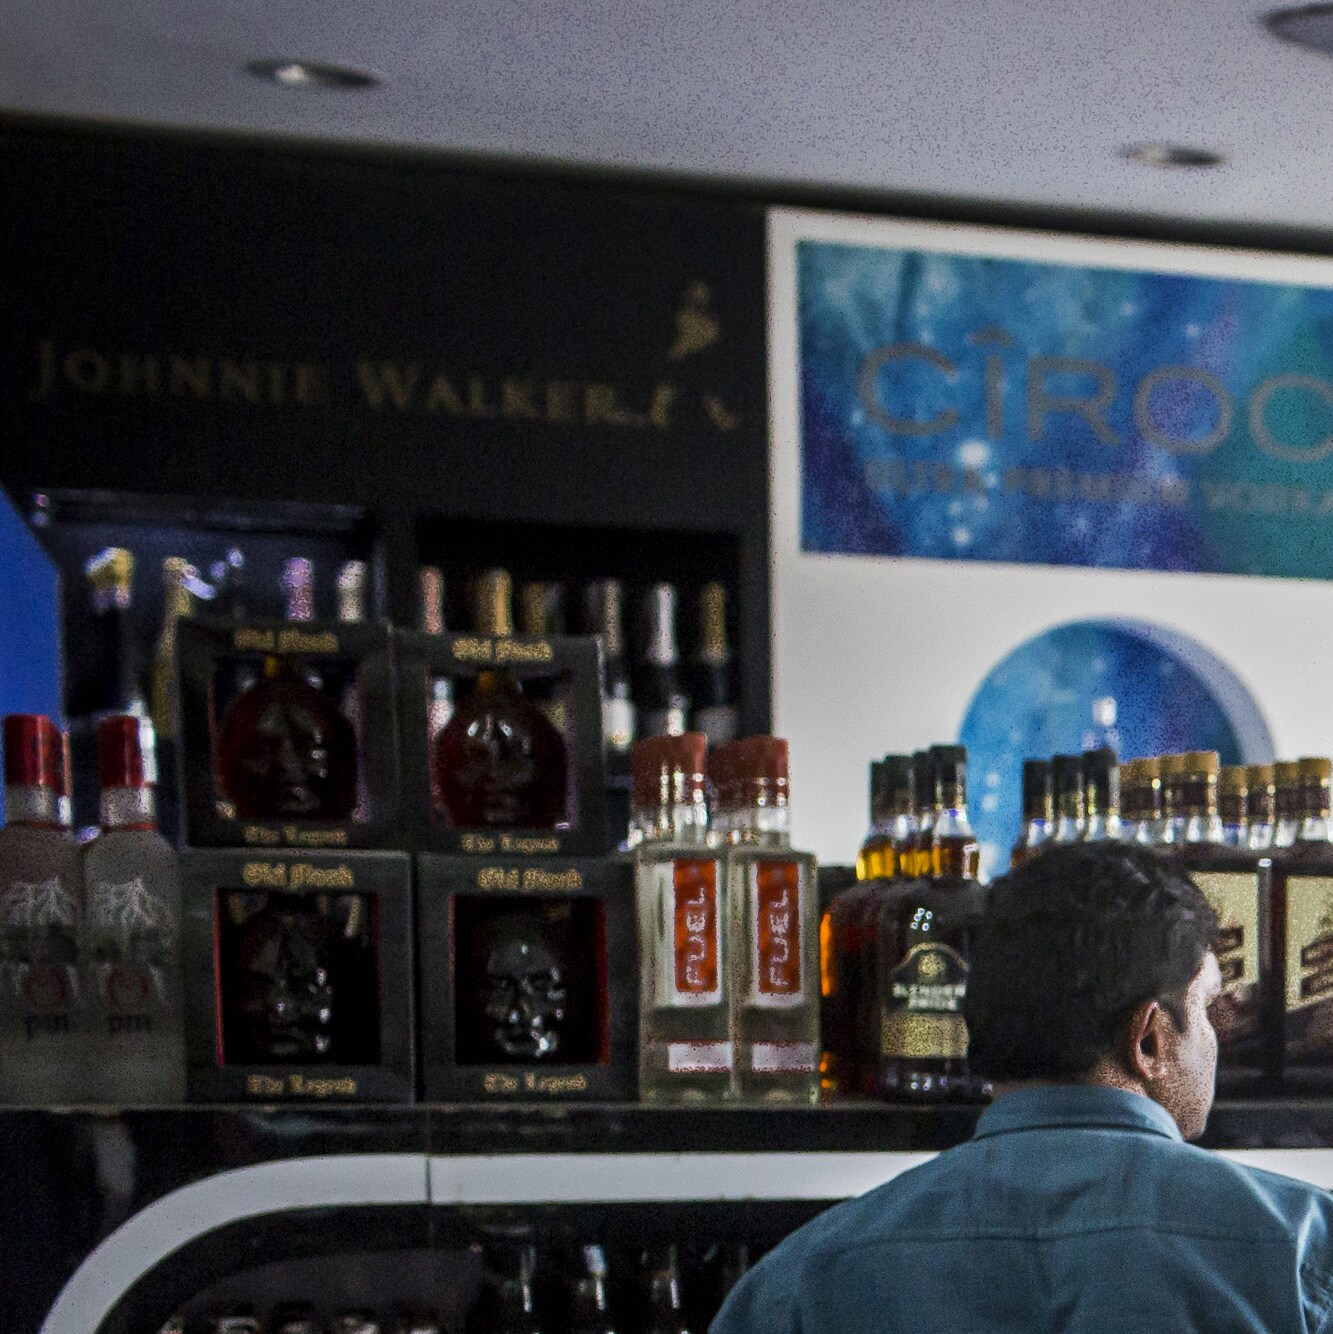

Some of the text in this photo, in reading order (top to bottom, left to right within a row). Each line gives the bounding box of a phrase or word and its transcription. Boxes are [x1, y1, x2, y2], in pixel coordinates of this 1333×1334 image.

[28, 335, 620, 427] JOHNNIE WALKER
[685, 886, 707, 986] FUEL
[769, 888, 790, 987] FUEL
